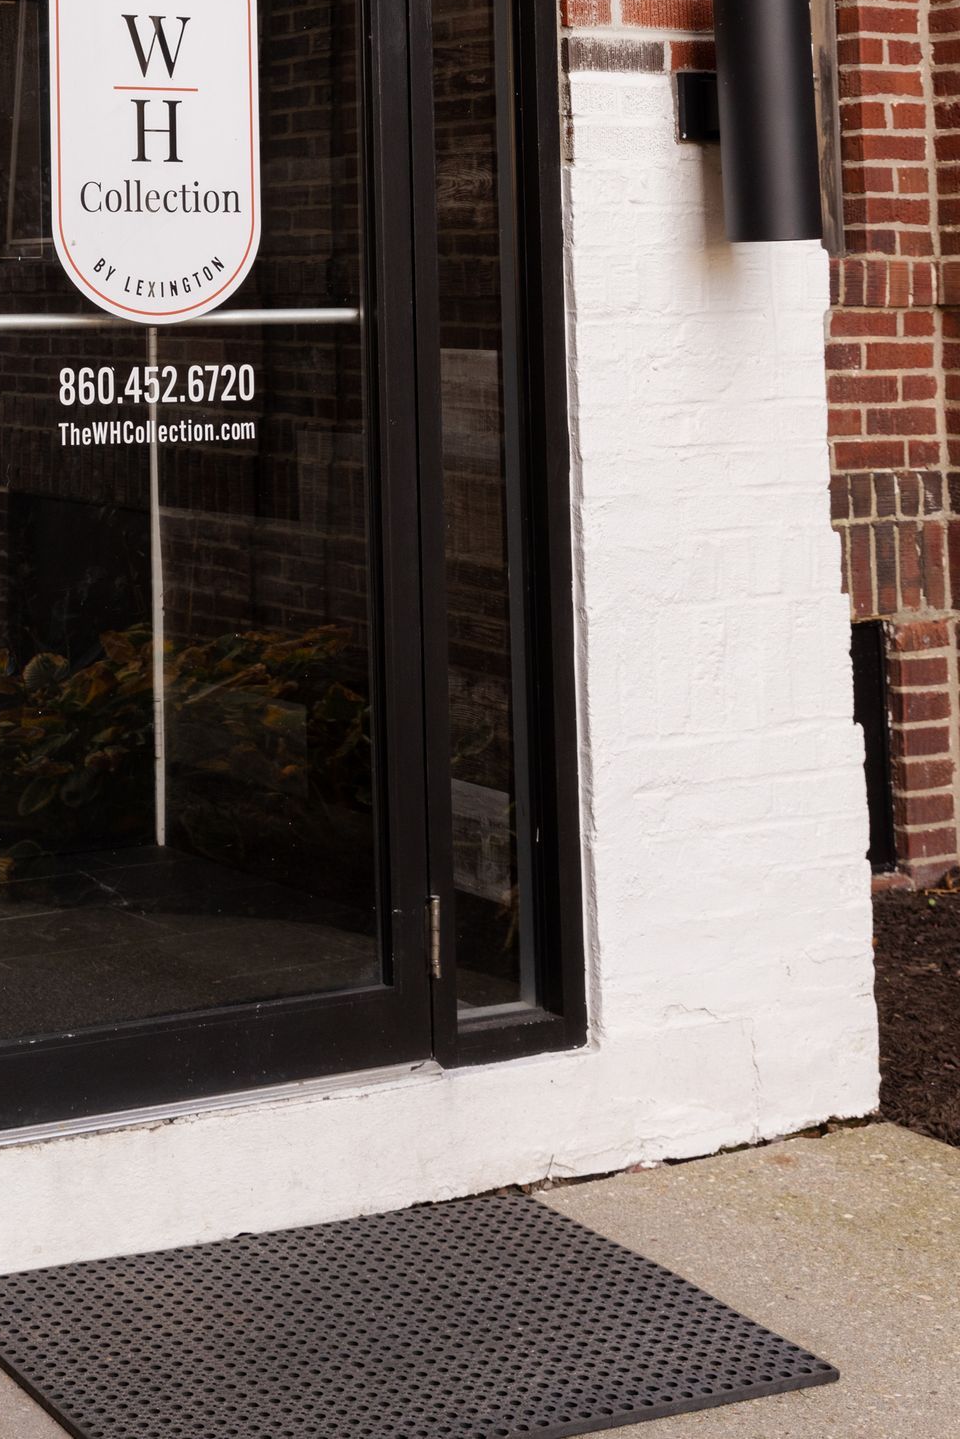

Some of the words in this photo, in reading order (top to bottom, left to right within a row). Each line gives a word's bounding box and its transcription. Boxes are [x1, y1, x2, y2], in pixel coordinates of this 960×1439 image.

[121, 14, 191, 79] W
[130, 99, 184, 163] H
[80, 179, 241, 214] Collection
[93, 258, 117, 282] BY
[124, 256, 226, 298] LEXINGTON
[59, 364, 255, 406] 860.452.6720
[58, 419, 256, 446] TheWHCollection.com
